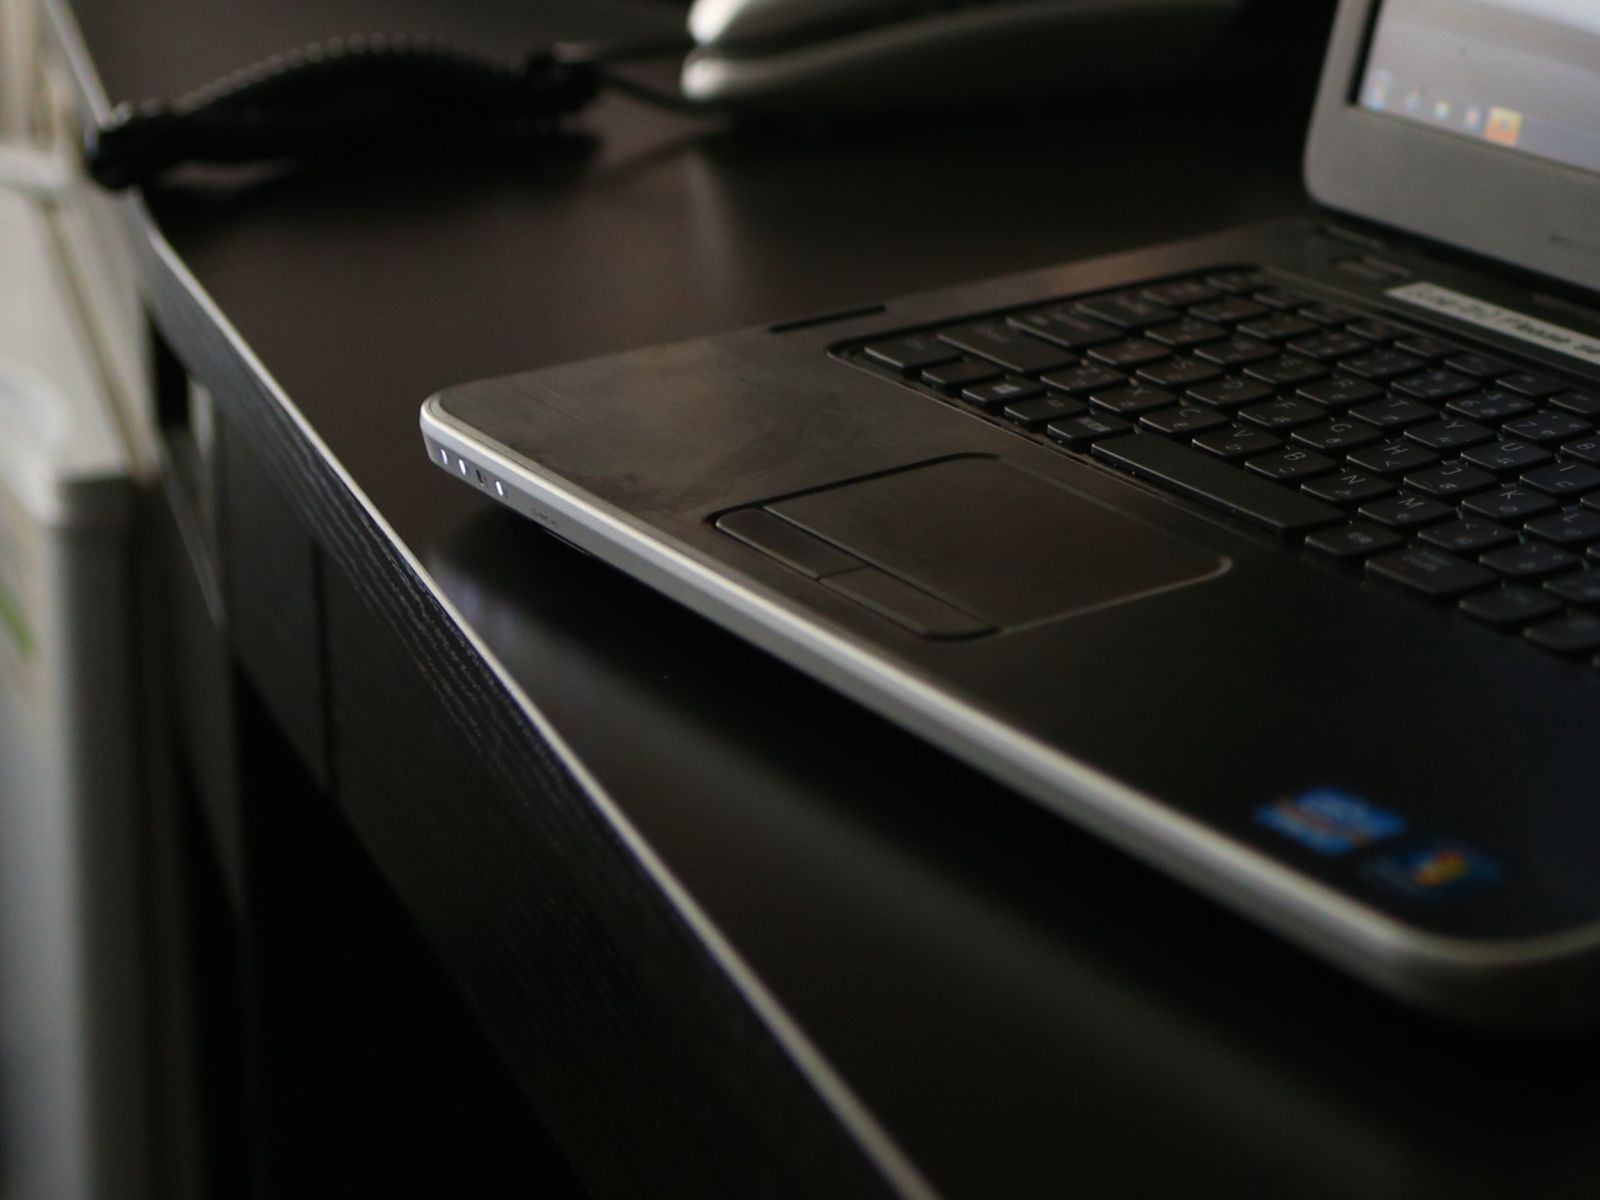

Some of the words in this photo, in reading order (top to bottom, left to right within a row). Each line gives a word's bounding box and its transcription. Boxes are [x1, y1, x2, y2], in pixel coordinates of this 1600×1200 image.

[1330, 422, 1352, 433] G
[1383, 445, 1409, 455] H
[1502, 442, 1524, 452] U
[1283, 451, 1307, 461] B
[1340, 474, 1366, 485] N
[1500, 489, 1525, 500] K
[1397, 497, 1425, 509] M
